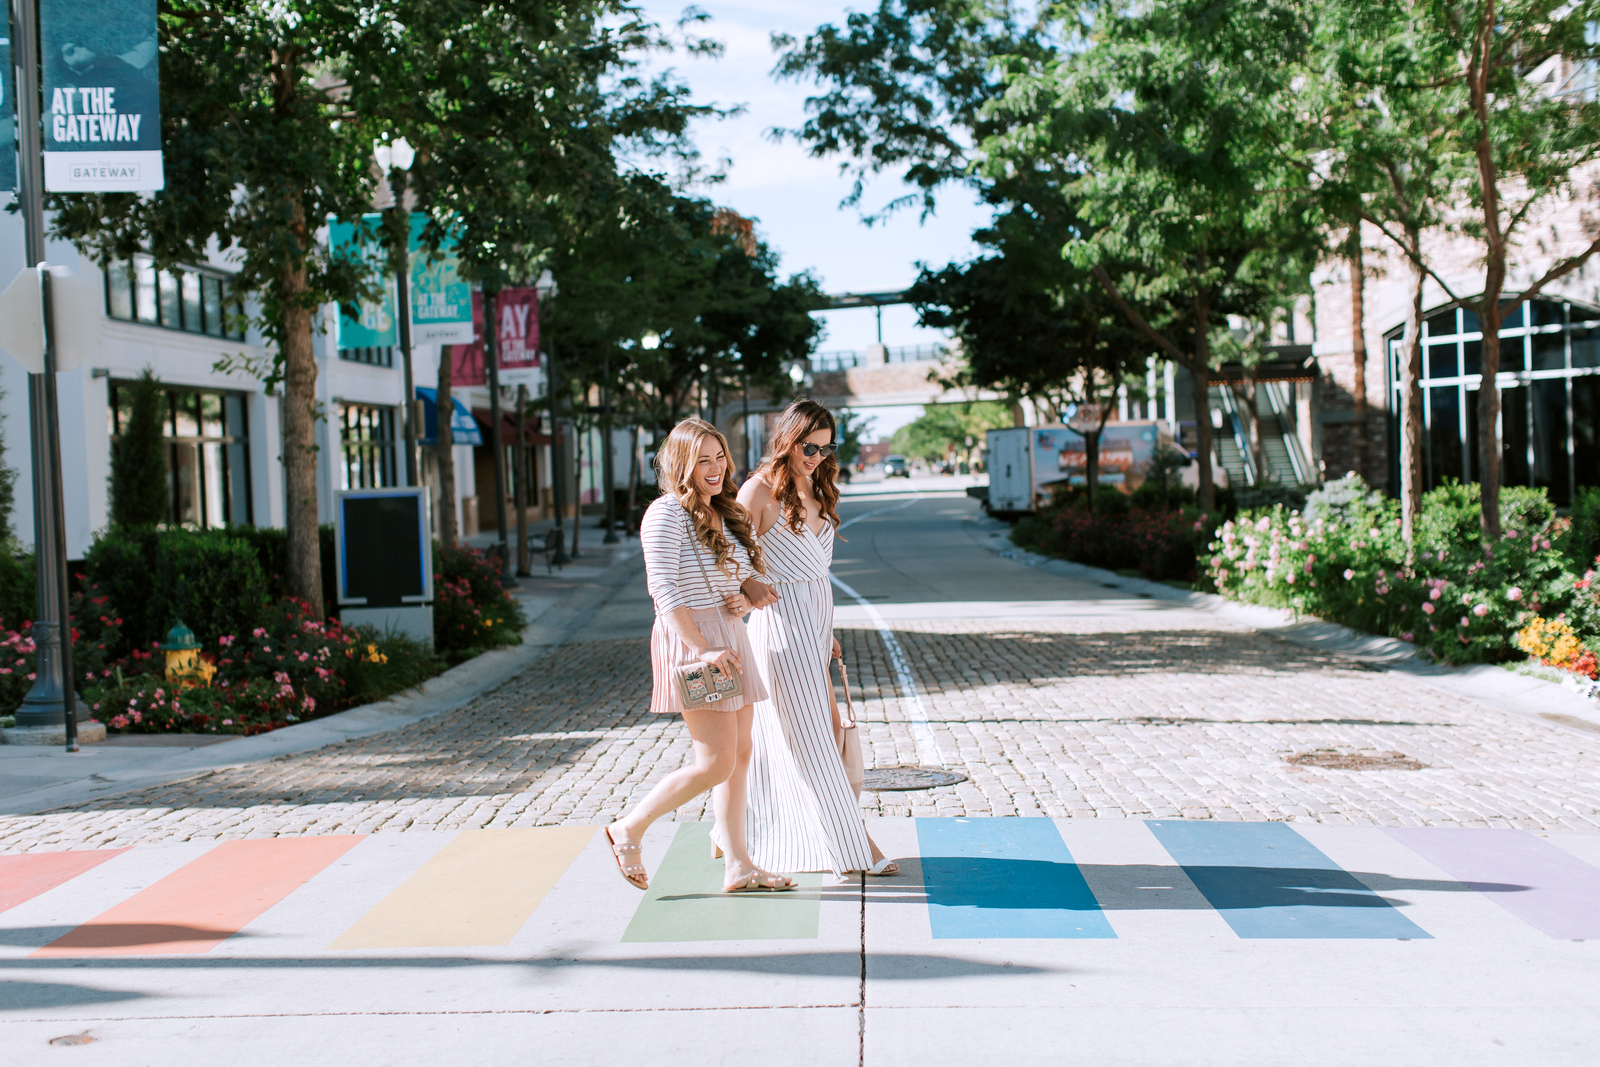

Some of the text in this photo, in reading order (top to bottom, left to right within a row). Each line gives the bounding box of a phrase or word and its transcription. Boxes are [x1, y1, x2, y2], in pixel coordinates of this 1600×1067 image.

[52, 87, 116, 115] AT THE
[53, 114, 141, 142] GATEWAY
[74, 168, 136, 178] GATEWAY
[501, 305, 530, 339] AY
